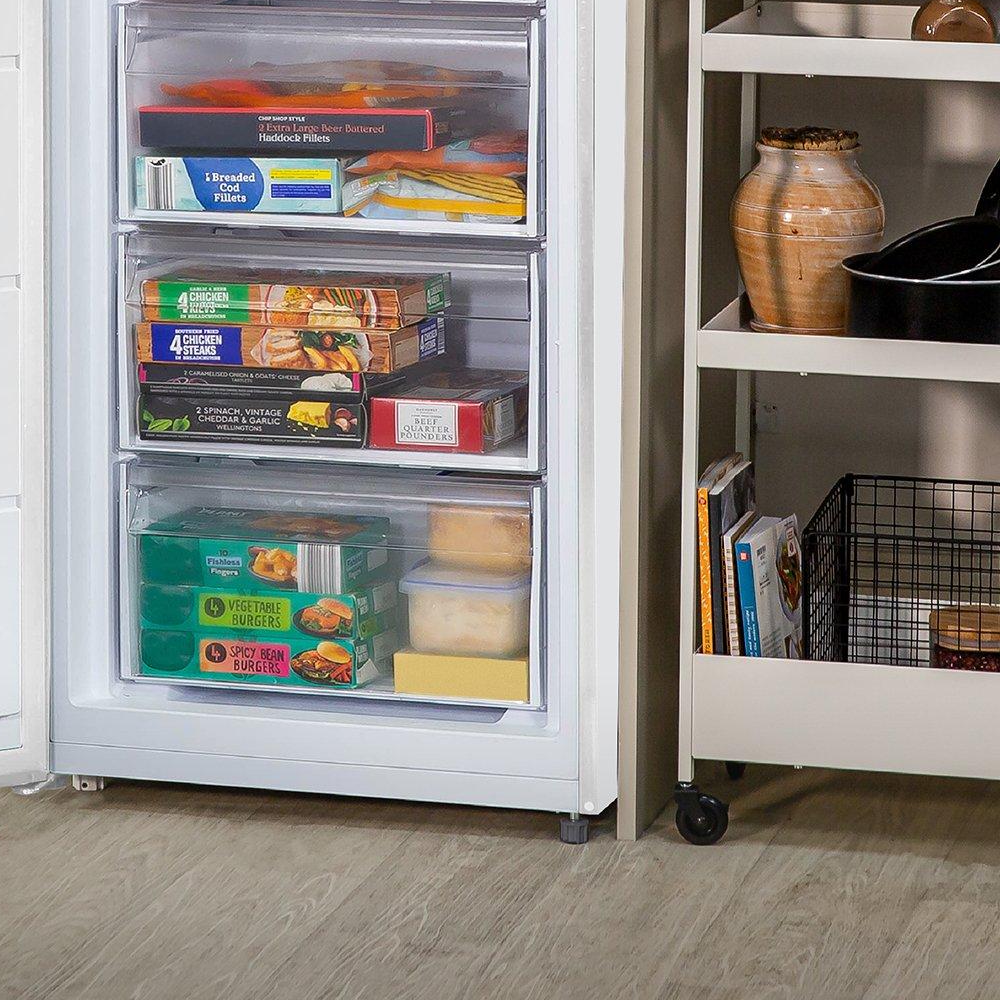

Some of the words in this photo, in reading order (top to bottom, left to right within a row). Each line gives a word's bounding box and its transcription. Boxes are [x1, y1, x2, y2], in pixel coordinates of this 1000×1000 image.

[258, 124, 265, 132] 2
[266, 123, 291, 132] Extra
[293, 124, 319, 134] Large
[321, 124, 342, 133] Beer
[345, 124, 385, 134] Battered
[258, 133, 301, 142] Haddock
[303, 133, 331, 143] Fillets
[212, 172, 256, 182] Breaded
[219, 183, 240, 192] Cod
[214, 193, 247, 203] Fillets
[177, 292, 188, 313] 4
[189, 292, 229, 301] CHICKEN
[170, 335, 183, 355] 4
[183, 335, 222, 345] CHICKEN
[183, 345, 217, 355] STEAKS
[188, 370, 228, 378] CARAMELISED
[196, 406, 201, 414] 2
[203, 407, 243, 416] SPINACH,
[244, 408, 282, 417] VINTAGE
[197, 414, 240, 424] CHEDDAR
[241, 416, 247, 424] &
[249, 416, 281, 425] GARLIC
[216, 424, 263, 432] WELLINGTONS
[403, 425, 450, 433] QUARTER
[400, 432, 454, 441] POUNDERS
[207, 558, 241, 566] Fishless
[210, 568, 239, 577] Fingers
[209, 598, 219, 616] 4
[229, 600, 281, 615] VEGETABLE
[232, 614, 282, 629] BURGERS
[210, 644, 220, 661] 4
[230, 646, 257, 659] SPICY
[260, 648, 285, 662] BEAN
[233, 659, 281, 674] BURGERS
